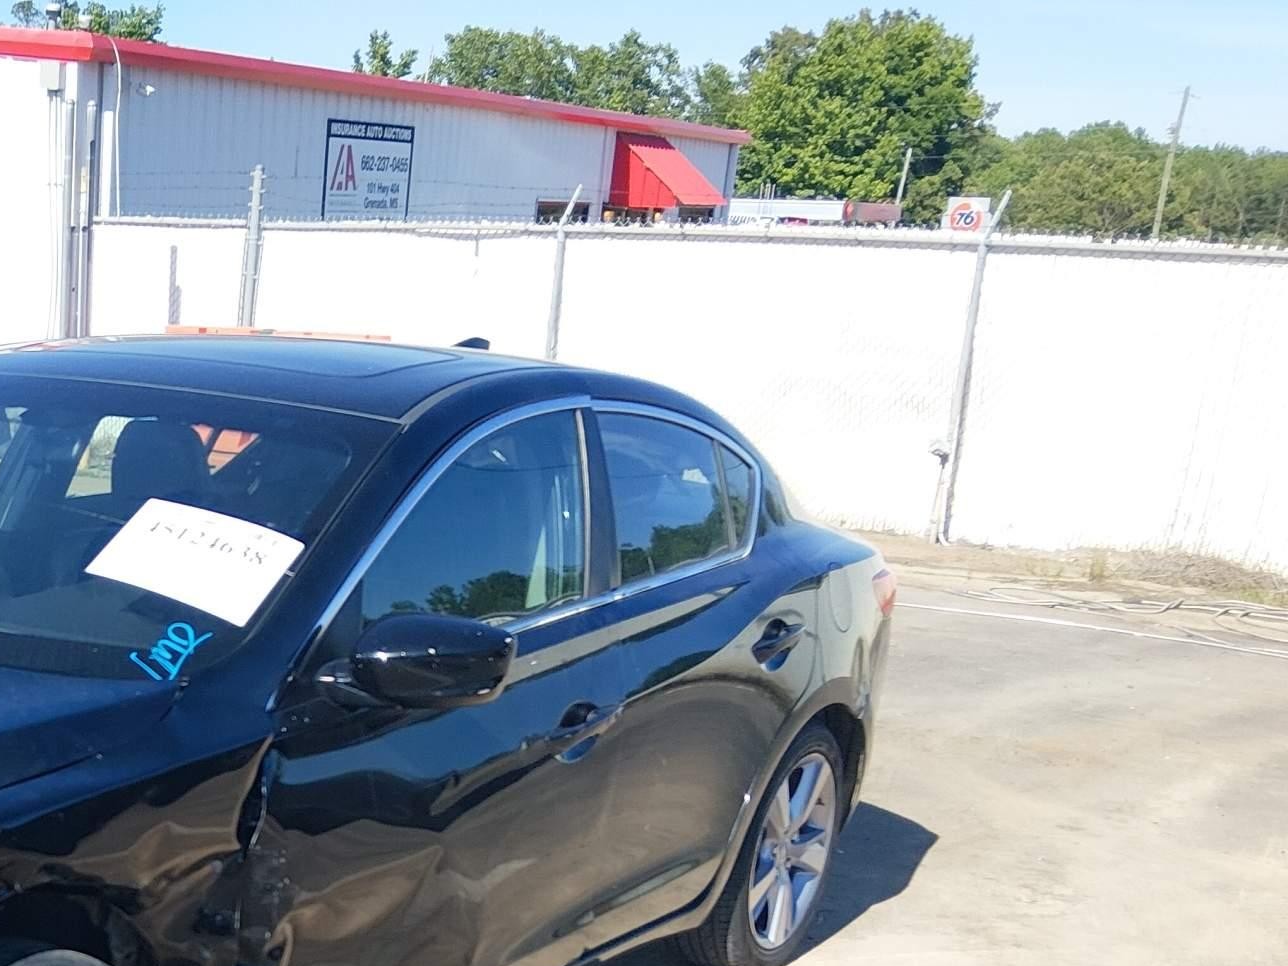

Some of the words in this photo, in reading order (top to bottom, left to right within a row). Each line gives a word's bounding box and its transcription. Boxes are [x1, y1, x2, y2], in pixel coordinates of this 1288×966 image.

[330, 122, 366, 137] INSURANCE
[366, 125, 383, 138] AUTO
[383, 126, 412, 141] AUCTIONS
[955, 210, 975, 226] 76
